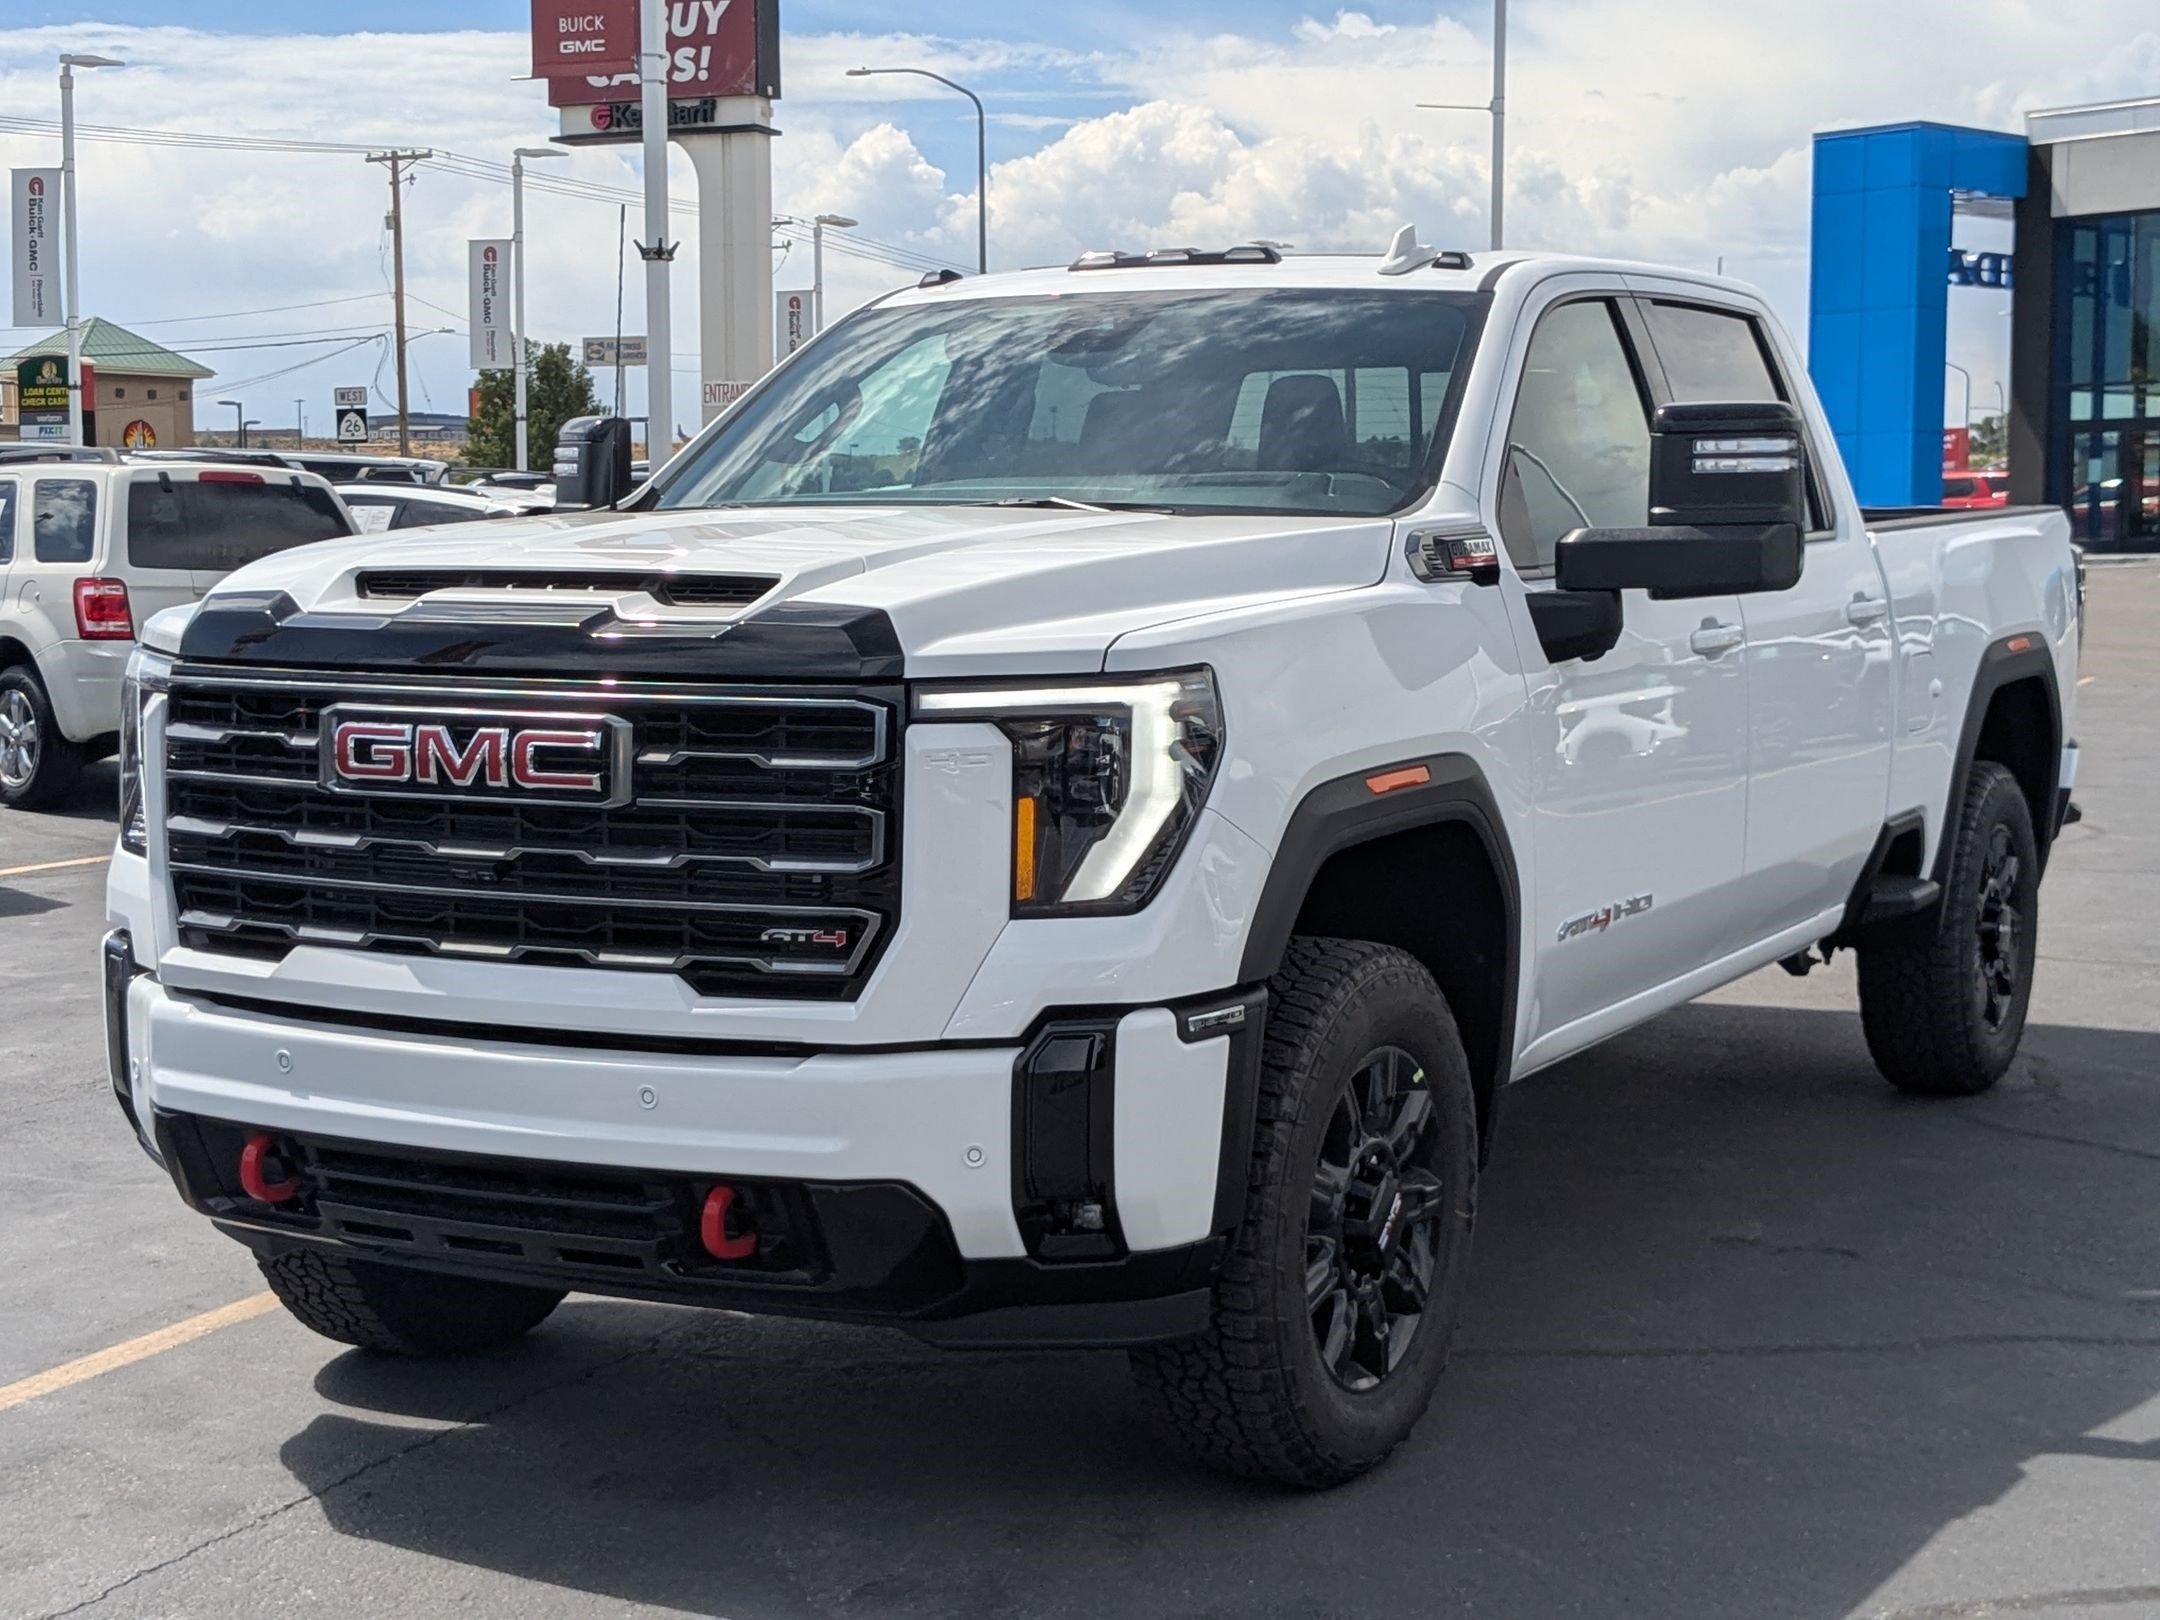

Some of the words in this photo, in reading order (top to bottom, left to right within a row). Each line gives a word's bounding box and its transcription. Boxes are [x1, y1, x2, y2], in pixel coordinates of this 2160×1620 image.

[558, 16, 604, 33] BUICK
[560, 39, 606, 54] GMC
[611, 103, 643, 128] Ke
[28, 198, 38, 234] Buick
[28, 240, 38, 271] GMC
[482, 298, 492, 324] GMC
[23, 388, 45, 397] LOAN
[340, 391, 362, 402] WEST
[704, 383, 755, 403] ENTRAN
[345, 418, 361, 433] 26
[1451, 540, 1493, 556] DURAMAX
[334, 720, 602, 793] GMC
[760, 928, 847, 948] AT4
